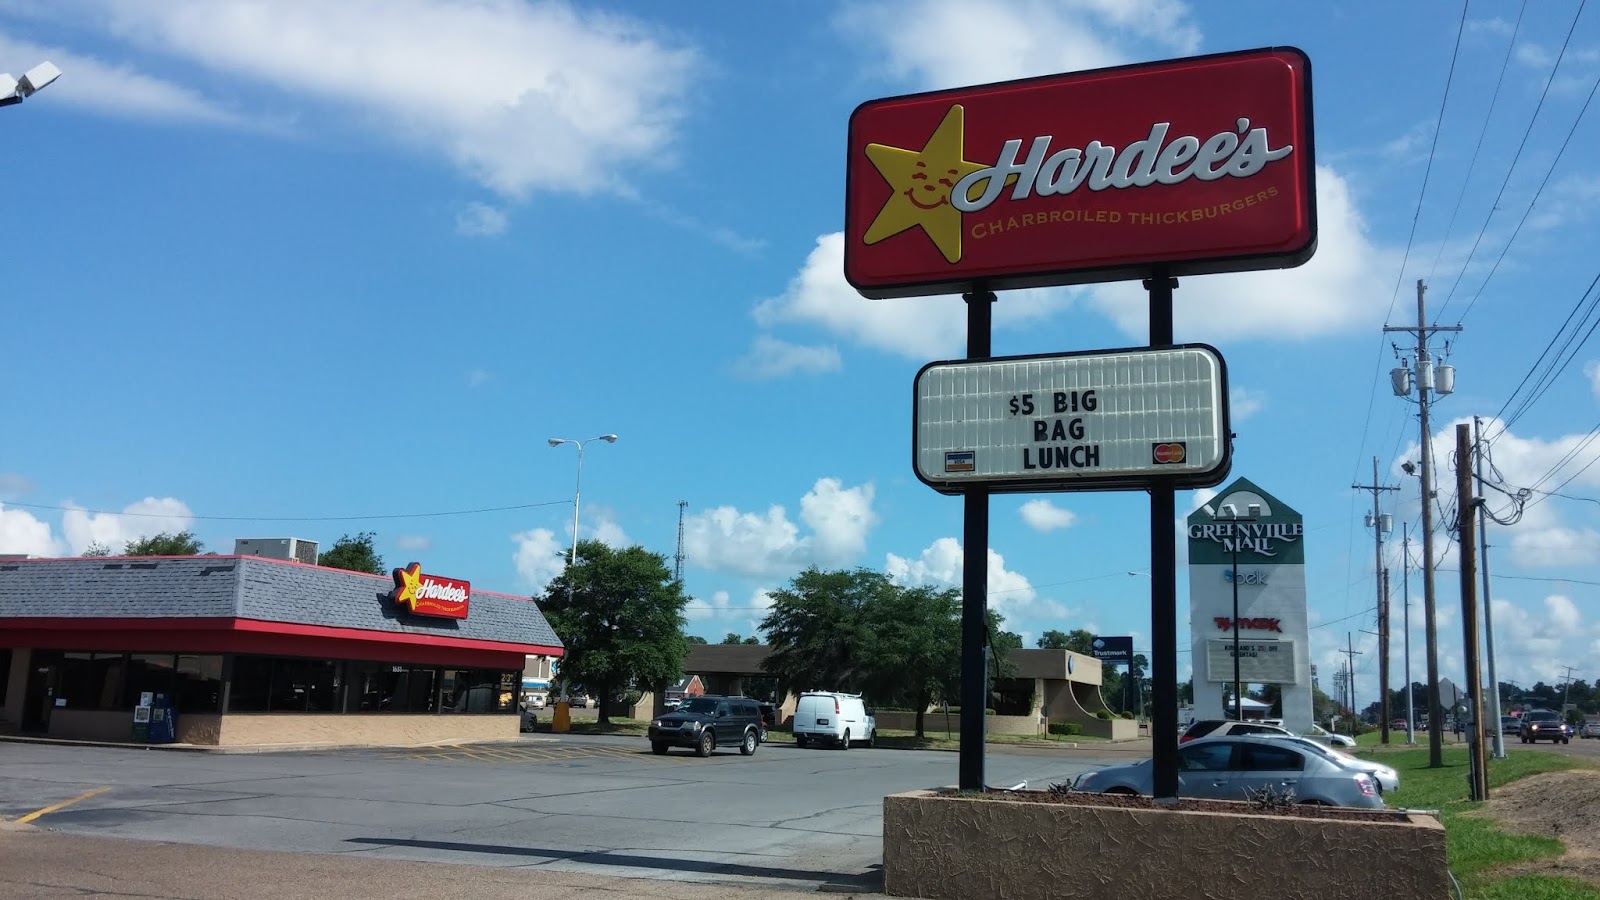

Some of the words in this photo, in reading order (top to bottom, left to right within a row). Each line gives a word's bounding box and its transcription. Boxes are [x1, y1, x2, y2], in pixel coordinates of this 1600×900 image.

[950, 117, 1293, 212] Hardee's
[970, 208, 1121, 239] CHARBROILED
[1127, 186, 1279, 225] THICKBURGERS
[1009, 393, 1035, 416] $5
[1053, 390, 1098, 413] BIG
[1033, 418, 1085, 442] BAG
[1023, 445, 1100, 470] LUNCH
[1187, 523, 1304, 543] GREENVILLE
[1222, 536, 1278, 556] MALL
[415, 578, 468, 602] Hardee's
